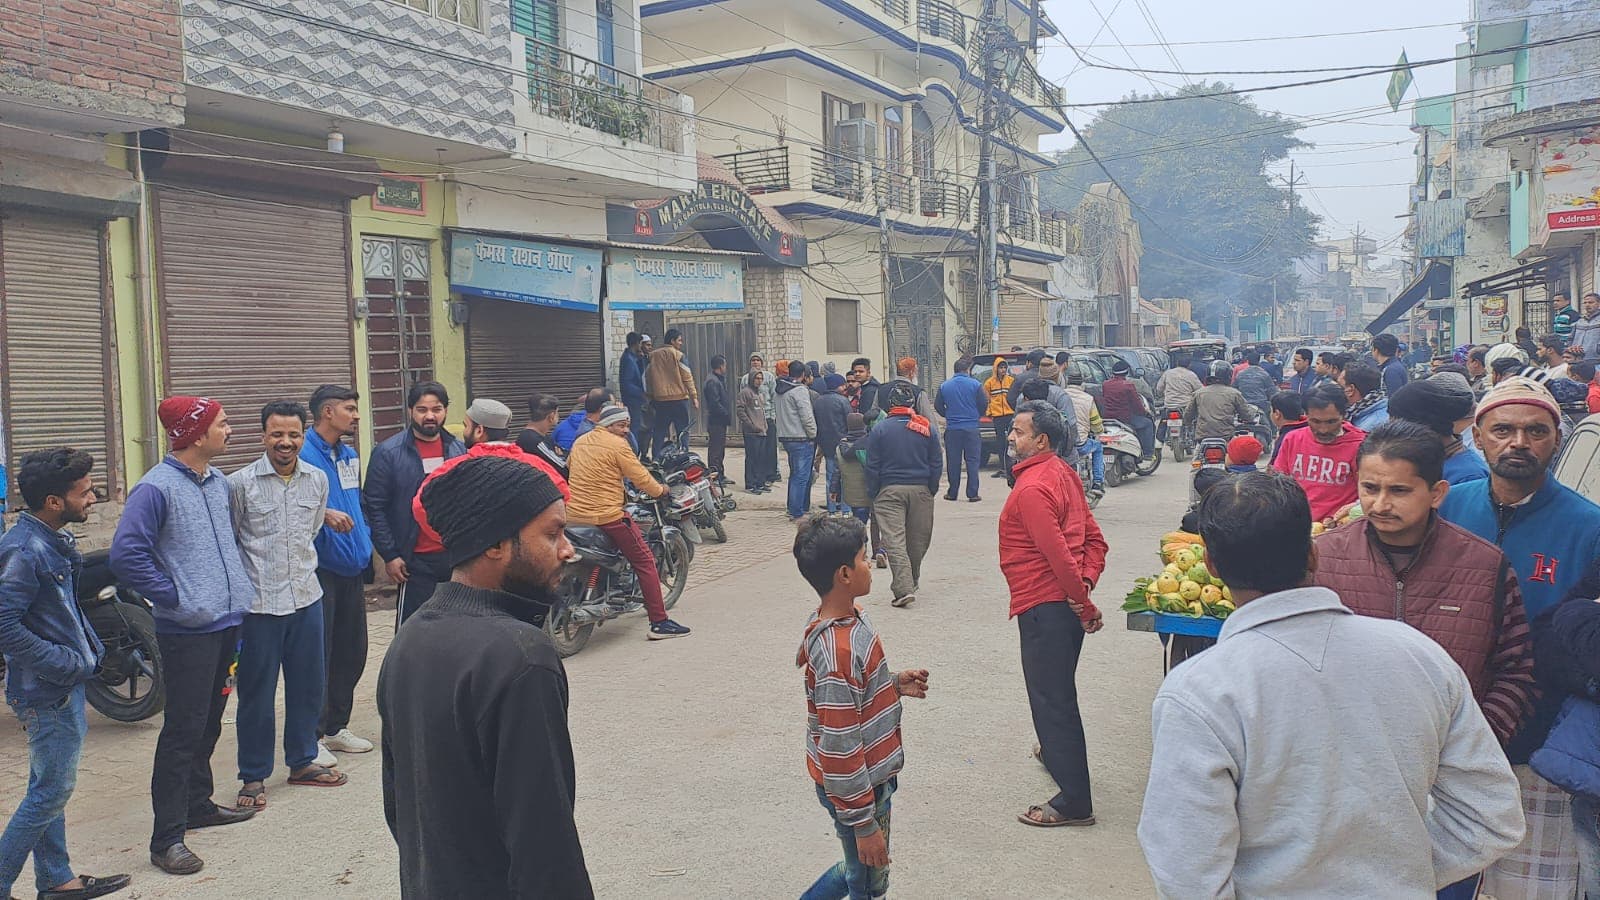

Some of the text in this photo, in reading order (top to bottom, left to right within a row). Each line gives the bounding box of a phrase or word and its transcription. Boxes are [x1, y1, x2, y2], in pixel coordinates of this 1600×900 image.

[711, 184, 773, 241] ENCLAVE
[511, 247, 543, 269] राशन
[546, 247, 574, 273] शॉप
[669, 259, 698, 278] राशन
[701, 256, 723, 279] शॉप
[1292, 453, 1351, 486] AERO
[1527, 553, 1560, 585] H
